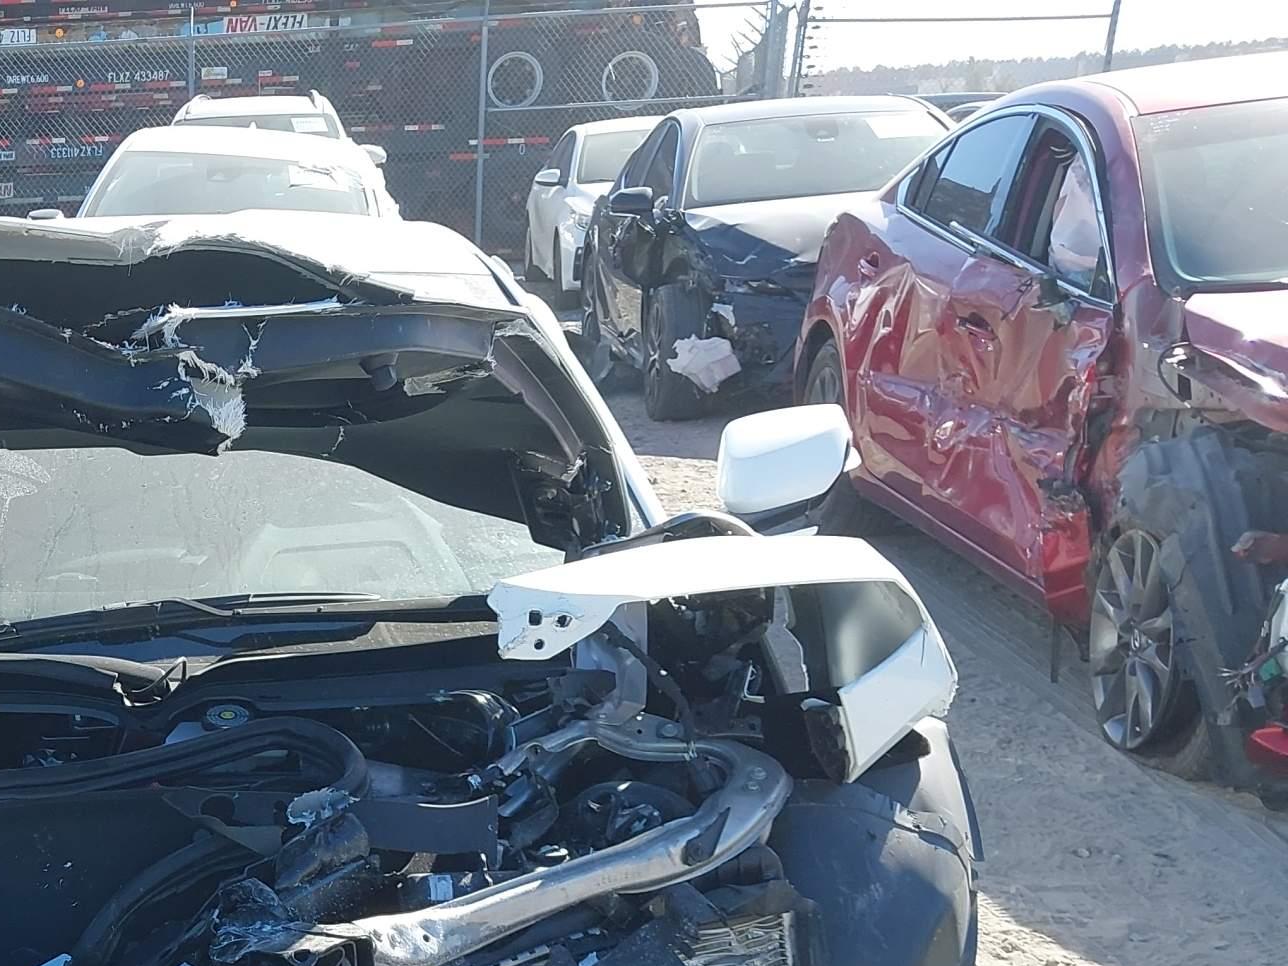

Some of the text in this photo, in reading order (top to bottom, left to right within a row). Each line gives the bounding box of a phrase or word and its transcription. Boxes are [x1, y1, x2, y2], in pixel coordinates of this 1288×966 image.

[226, 15, 305, 33] FLEXI-VAN
[10, 29, 32, 39] FLTZ
[108, 70, 170, 83] FLXZ 433487
